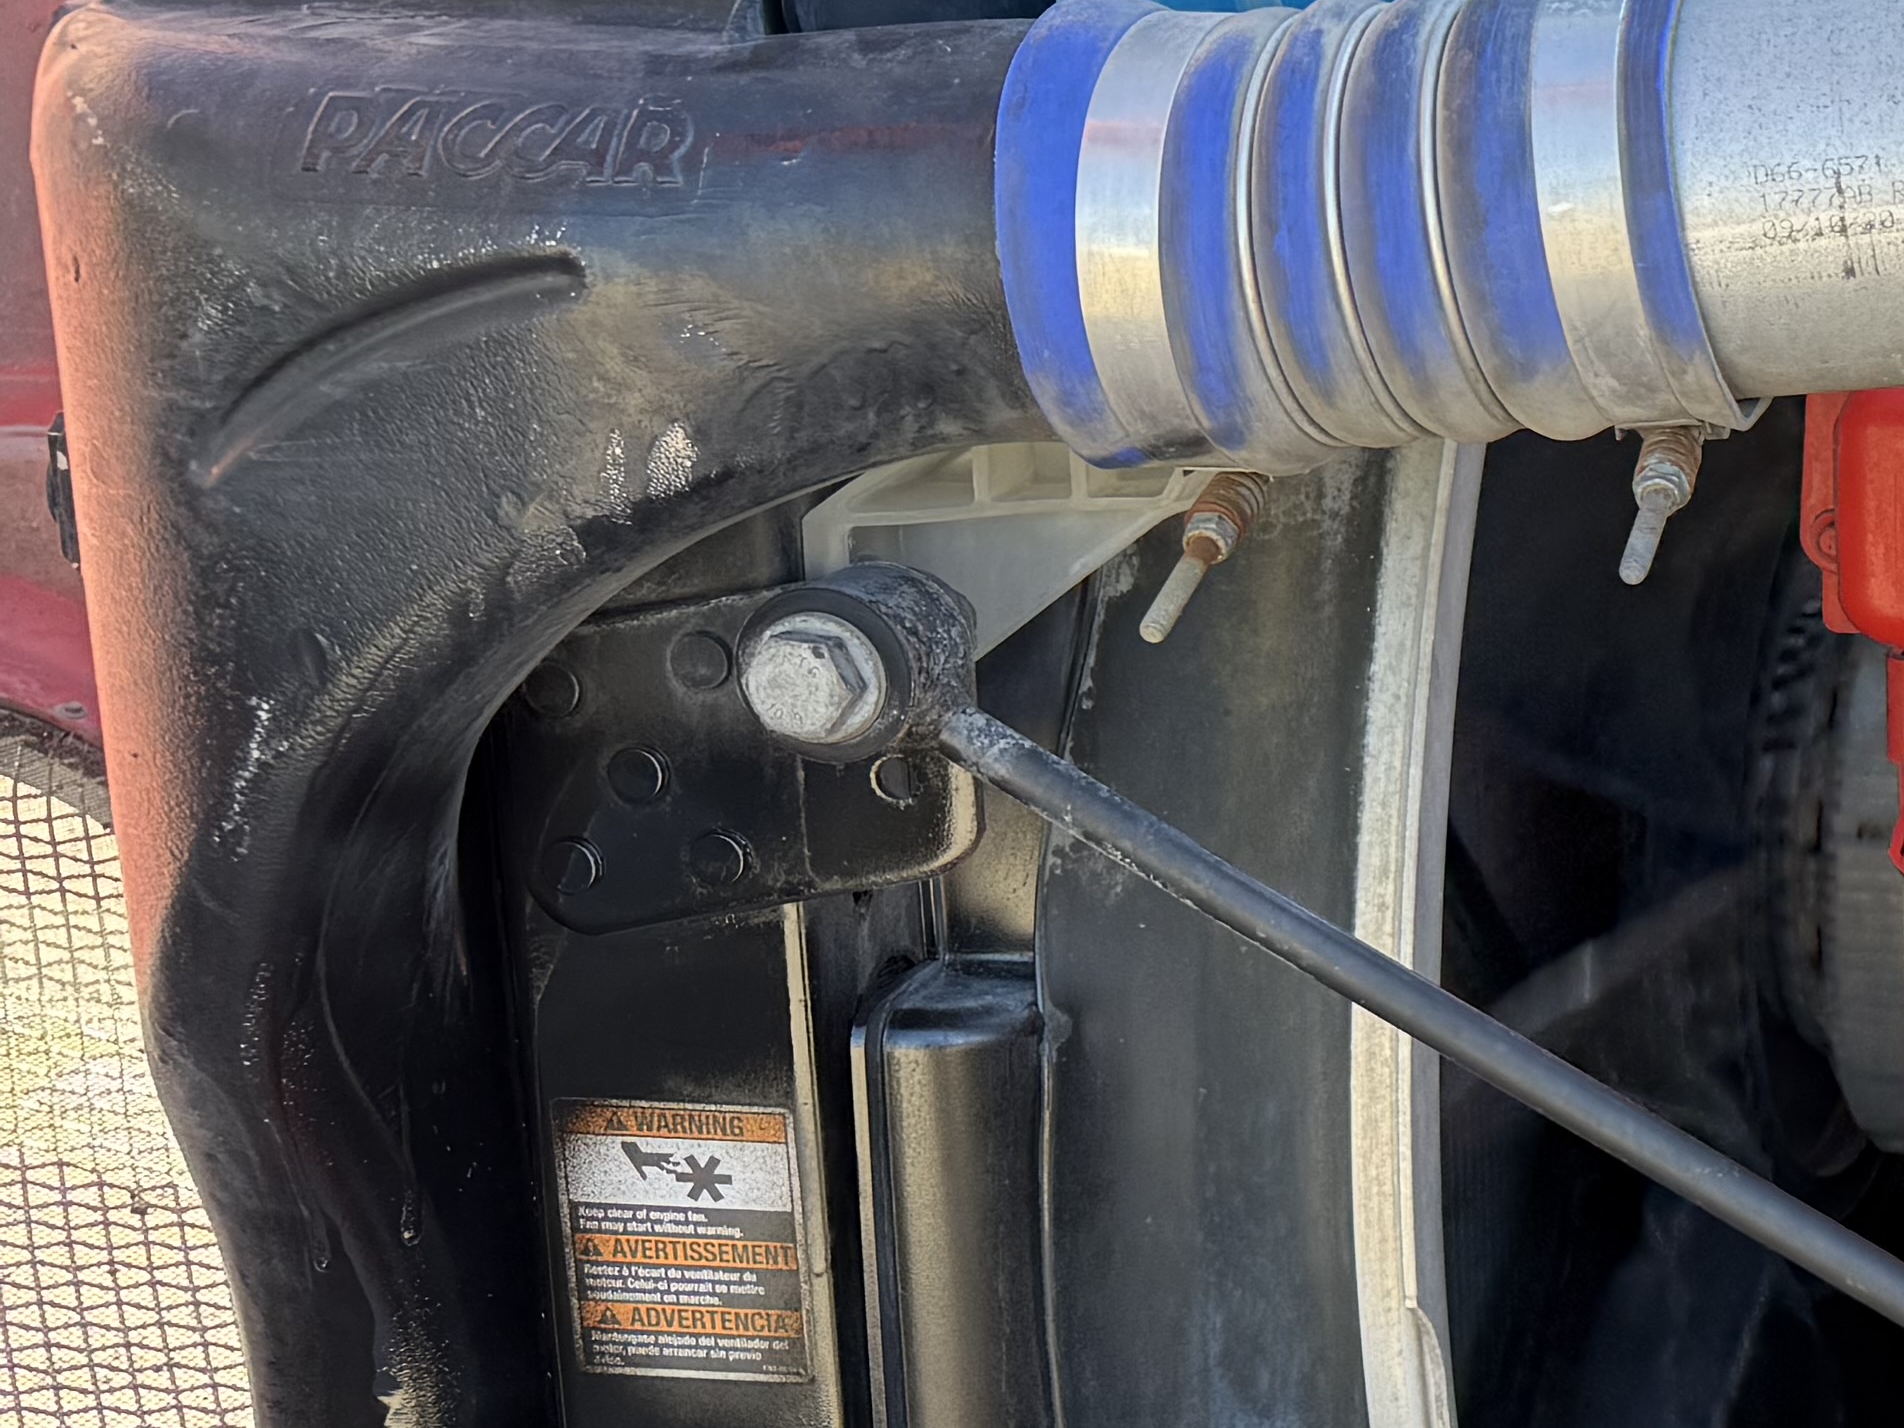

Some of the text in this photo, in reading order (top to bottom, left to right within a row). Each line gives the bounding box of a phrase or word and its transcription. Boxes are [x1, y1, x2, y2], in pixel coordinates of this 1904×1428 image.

[302, 89, 695, 187] PACCAR
[633, 1111, 745, 1137] WARNING
[608, 1208, 633, 1219] clear
[636, 1209, 647, 1220] of
[650, 1211, 685, 1222] engine
[580, 1219, 744, 1239] Fan may start without warning.
[612, 1237, 792, 1266] AVERTISSEMENT
[630, 1307, 788, 1333] ADVERTENCIA
